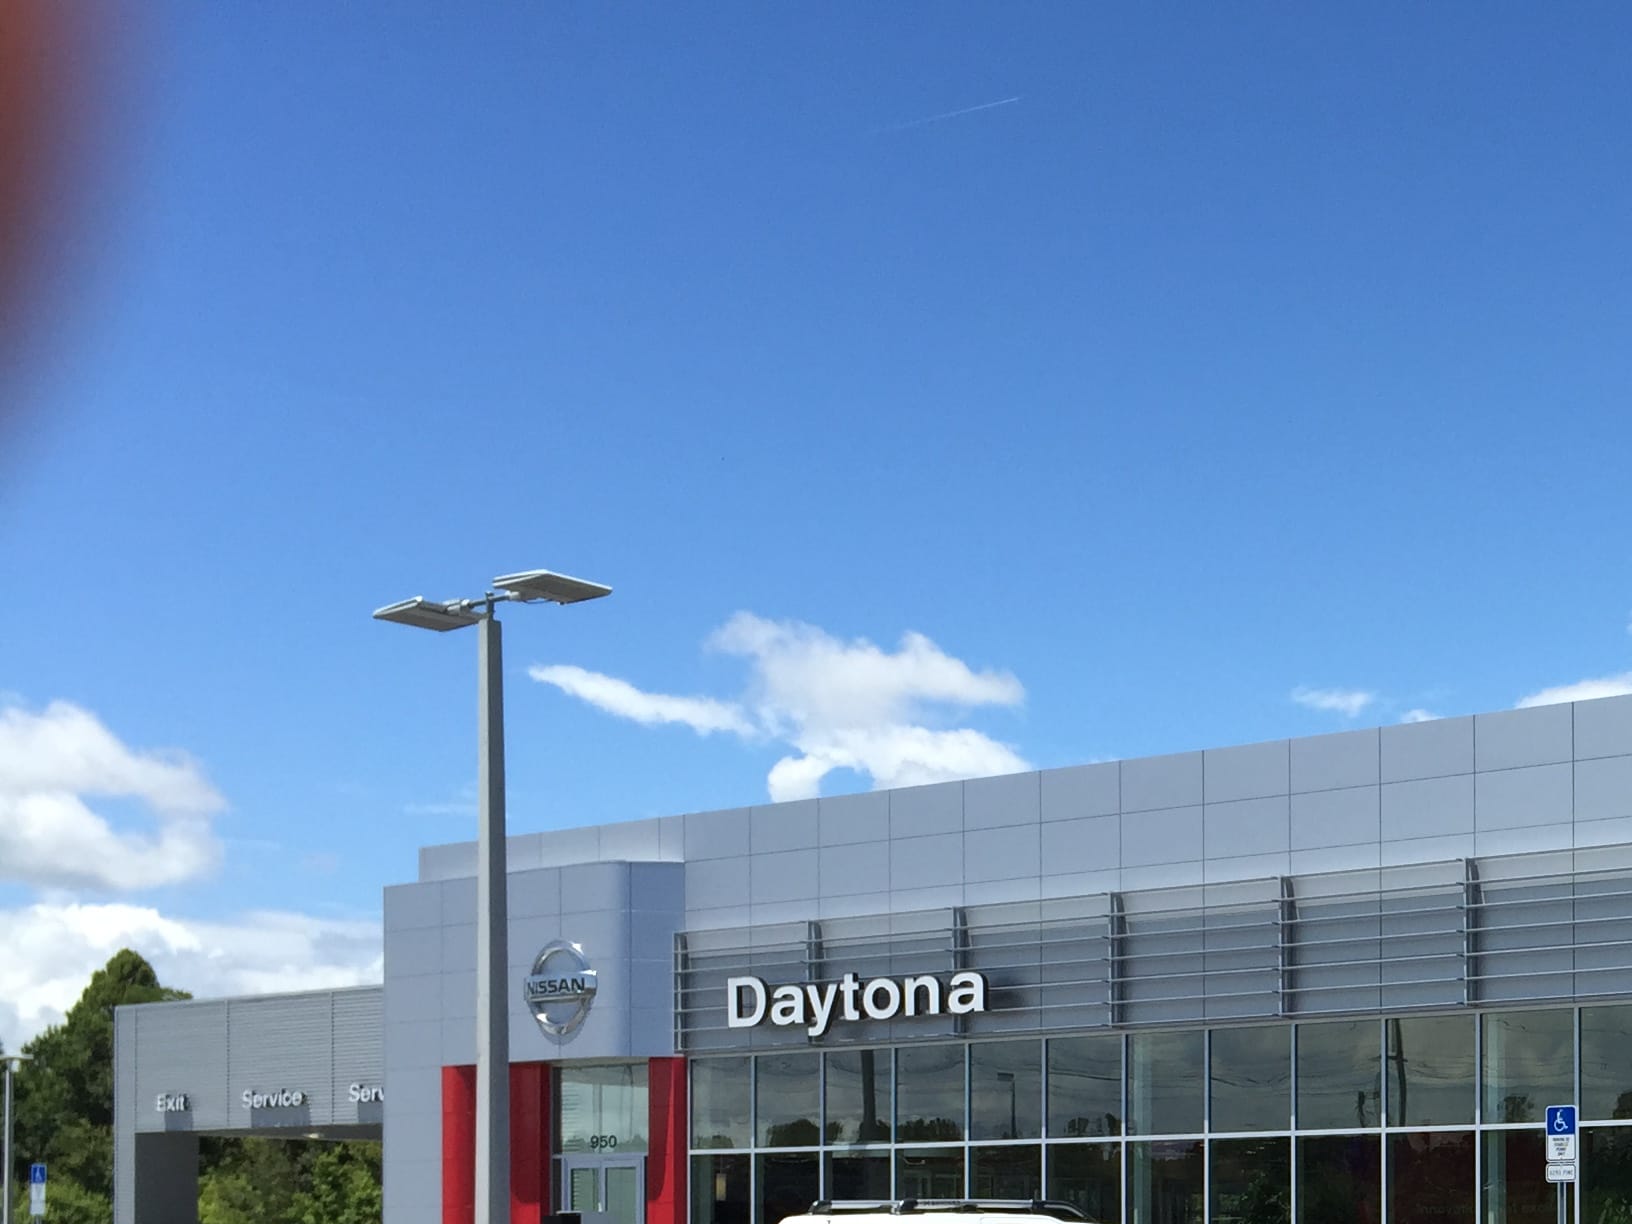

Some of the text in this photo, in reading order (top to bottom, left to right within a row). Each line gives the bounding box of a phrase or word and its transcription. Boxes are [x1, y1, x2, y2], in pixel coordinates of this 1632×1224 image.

[527, 977, 585, 995] NISSAN
[727, 971, 985, 1036] Daytona
[156, 1094, 187, 1112] Exit
[242, 1089, 304, 1109] Service
[590, 1135, 617, 1148] 950
